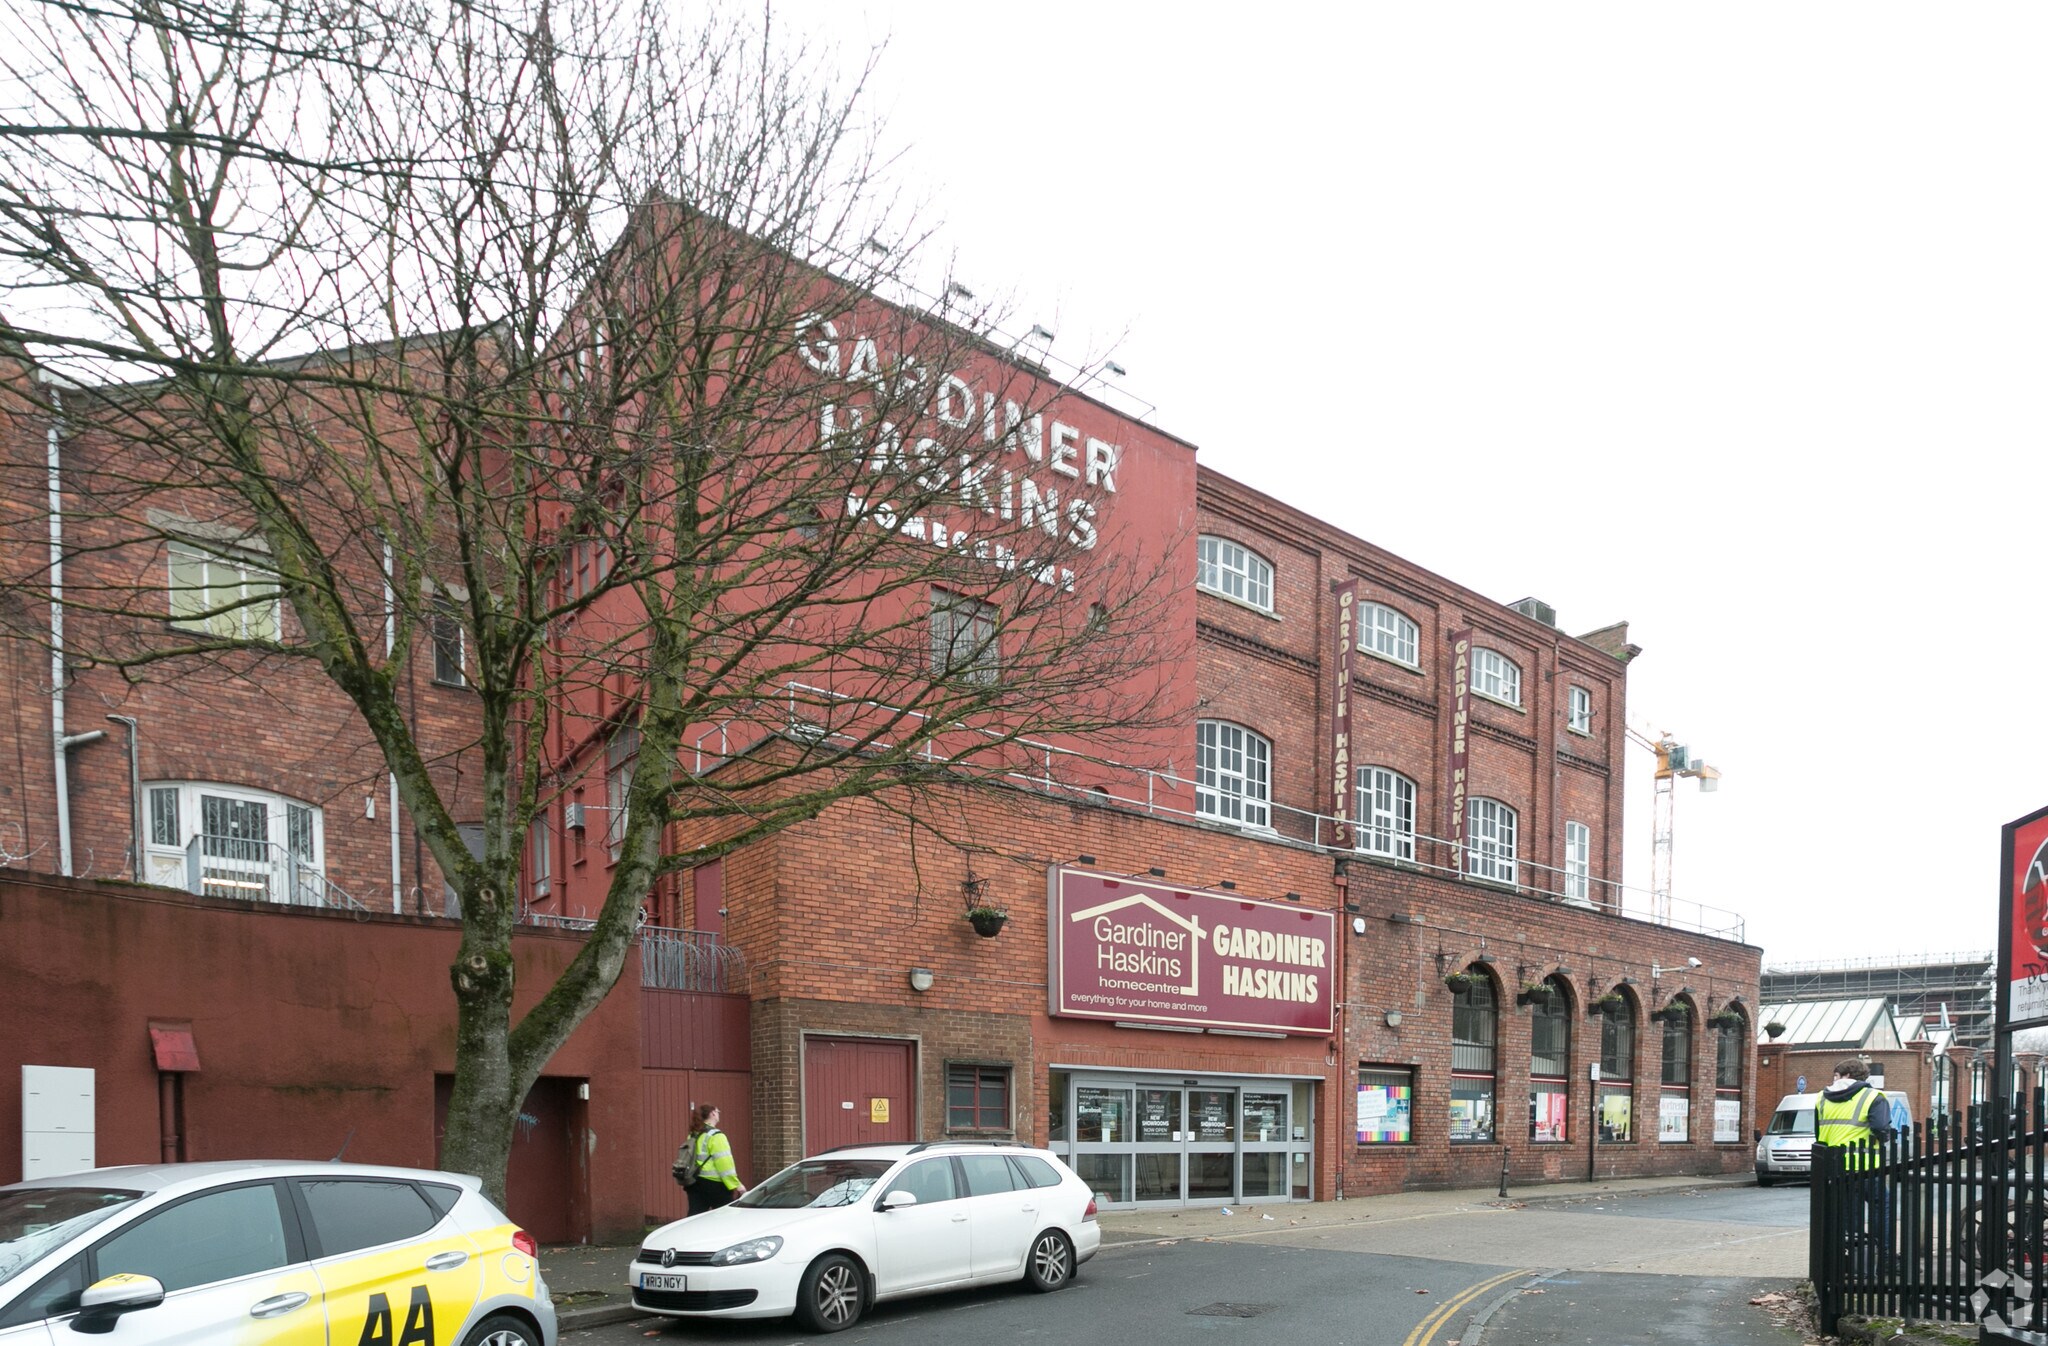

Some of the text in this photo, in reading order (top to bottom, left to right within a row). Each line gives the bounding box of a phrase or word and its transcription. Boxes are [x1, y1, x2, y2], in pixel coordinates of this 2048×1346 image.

[820, 398, 1097, 551] HASKINS
[1333, 591, 1353, 841] GARDINER HASKINS
[1450, 640, 1468, 868] GARDINER HASKINS
[1094, 915, 1187, 951] Gardiner
[1212, 924, 1326, 968] GARDINER
[1098, 944, 1181, 978] Haskins
[1070, 992, 1208, 1013] everything for your home and more
[1099, 975, 1180, 995] homecentre
[1223, 964, 1319, 1004] HASKINS
[110, 1273, 132, 1283] AA
[645, 1275, 681, 1289] WR13 NGY
[358, 1285, 436, 1346] AA
